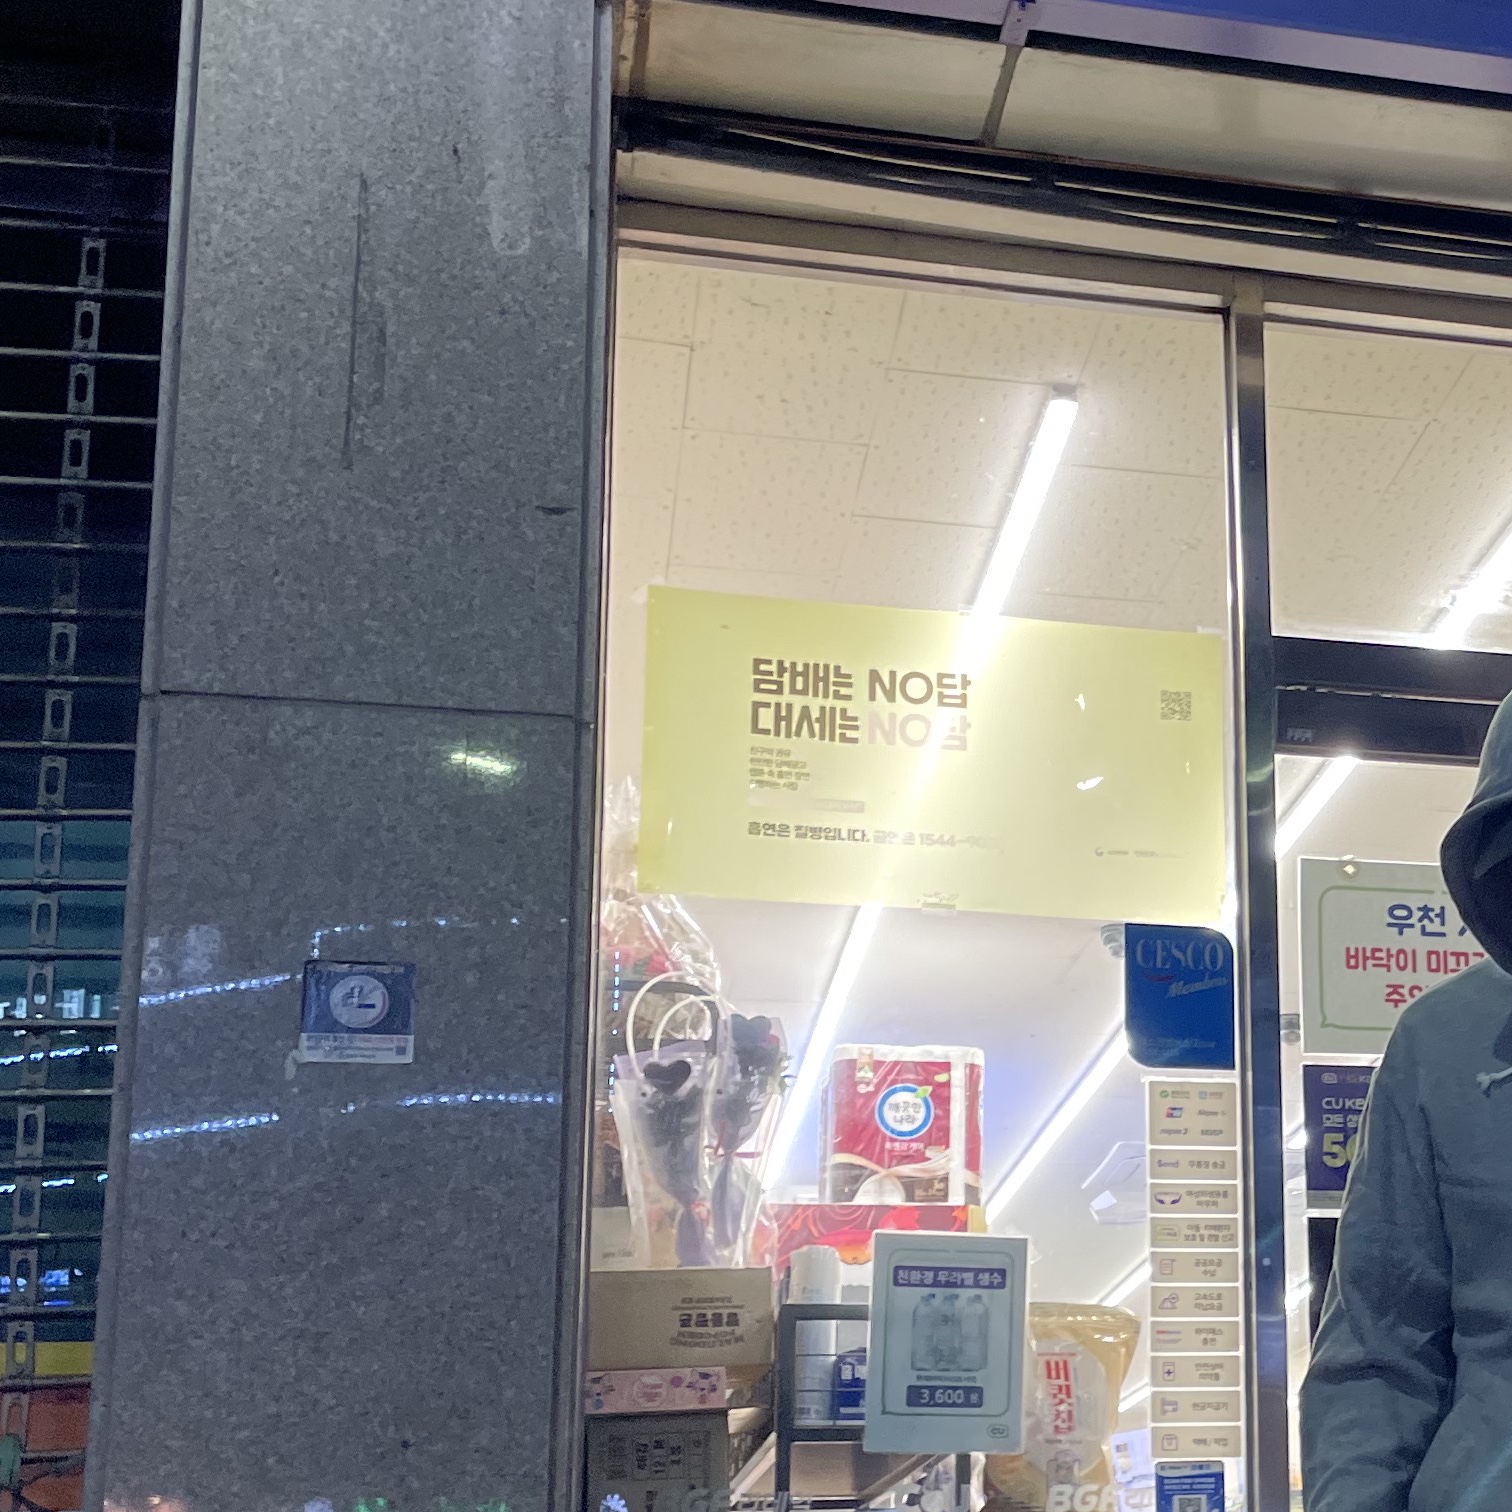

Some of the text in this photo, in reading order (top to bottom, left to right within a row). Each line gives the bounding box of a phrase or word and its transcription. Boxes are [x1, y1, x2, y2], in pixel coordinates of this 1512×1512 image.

[752, 657, 972, 709] 담배는 NO답
[751, 700, 860, 744] 대세는
[748, 821, 791, 838] 흡연은
[793, 824, 870, 843] 질병입니다.
[1386, 903, 1447, 938] 우천
[1135, 939, 1224, 971] CESCO
[1344, 946, 1418, 974] 바닥이
[1321, 1097, 1343, 1110] CU
[919, 1388, 965, 1405] 3,600
